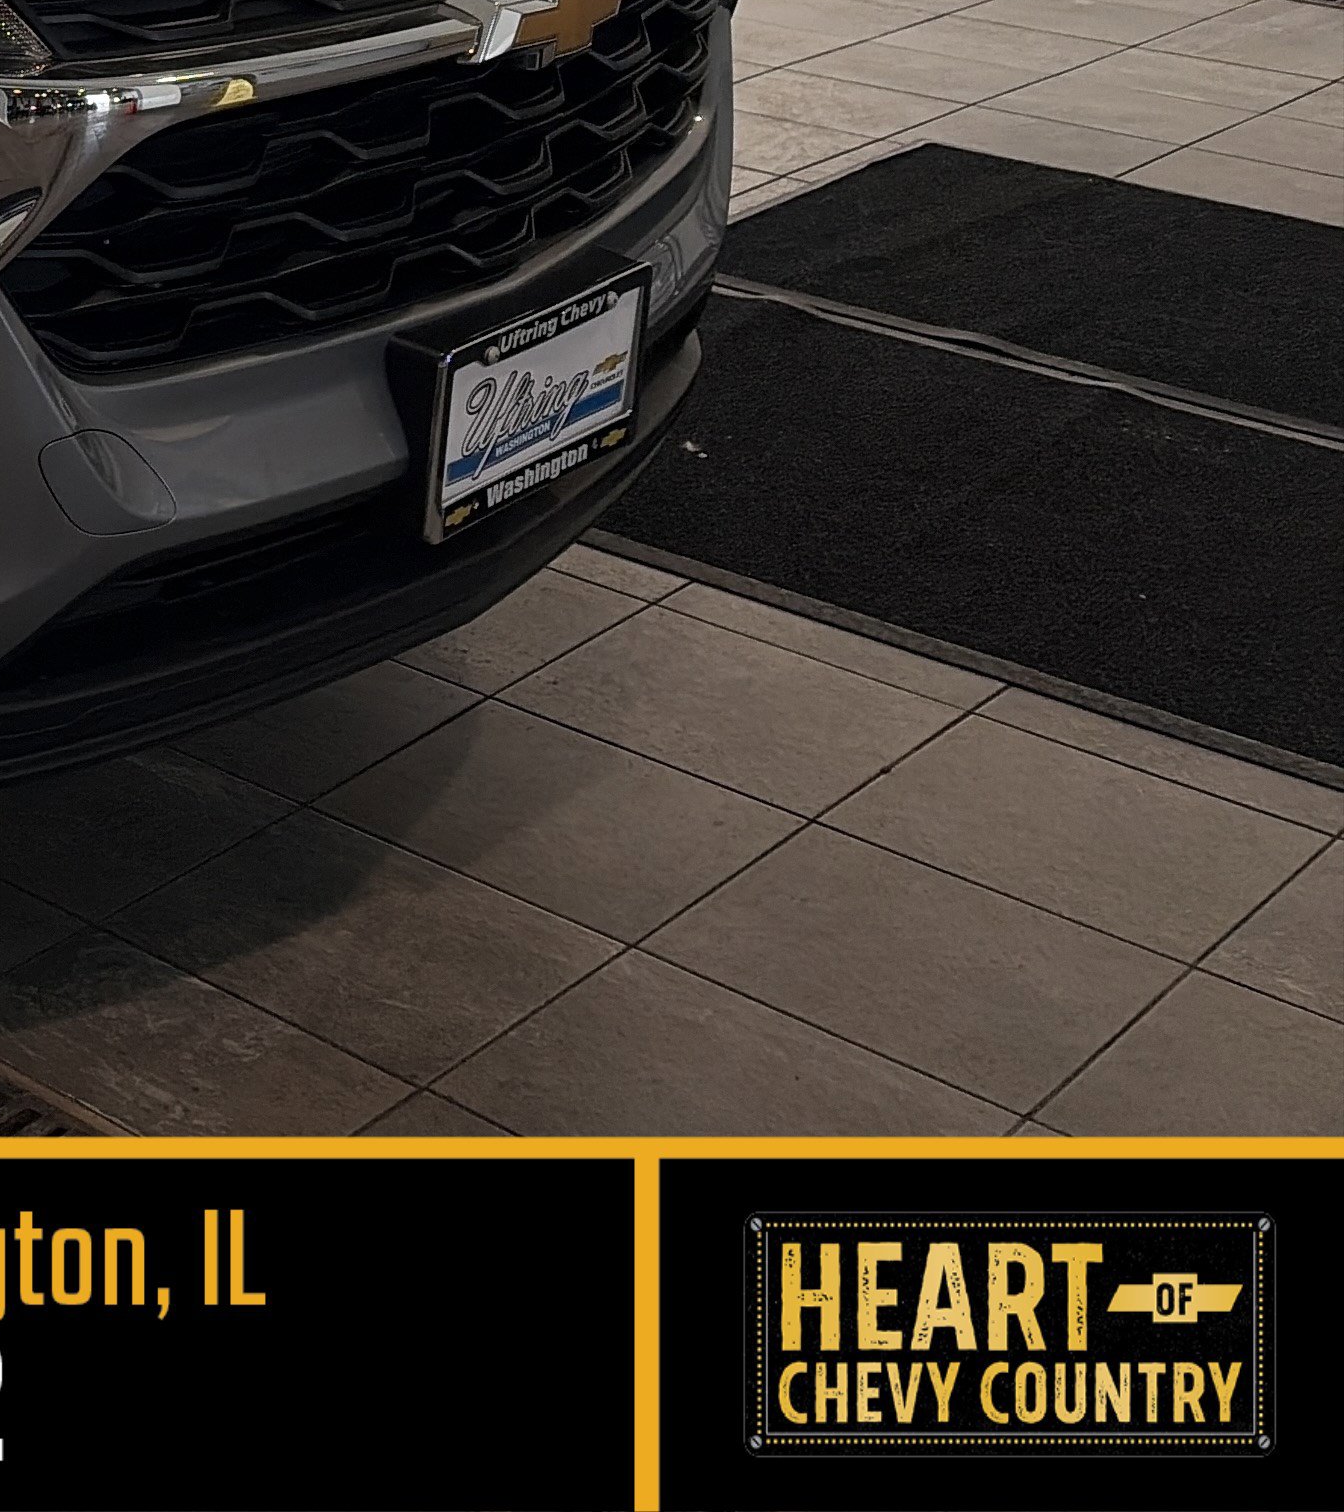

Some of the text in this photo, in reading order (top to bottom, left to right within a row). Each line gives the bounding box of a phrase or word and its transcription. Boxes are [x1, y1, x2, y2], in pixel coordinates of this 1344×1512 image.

[500, 293, 607, 353] Uftring Chevy
[462, 370, 590, 481] Uftring
[495, 420, 551, 457] WASHINGTON
[486, 443, 589, 509] Washington
